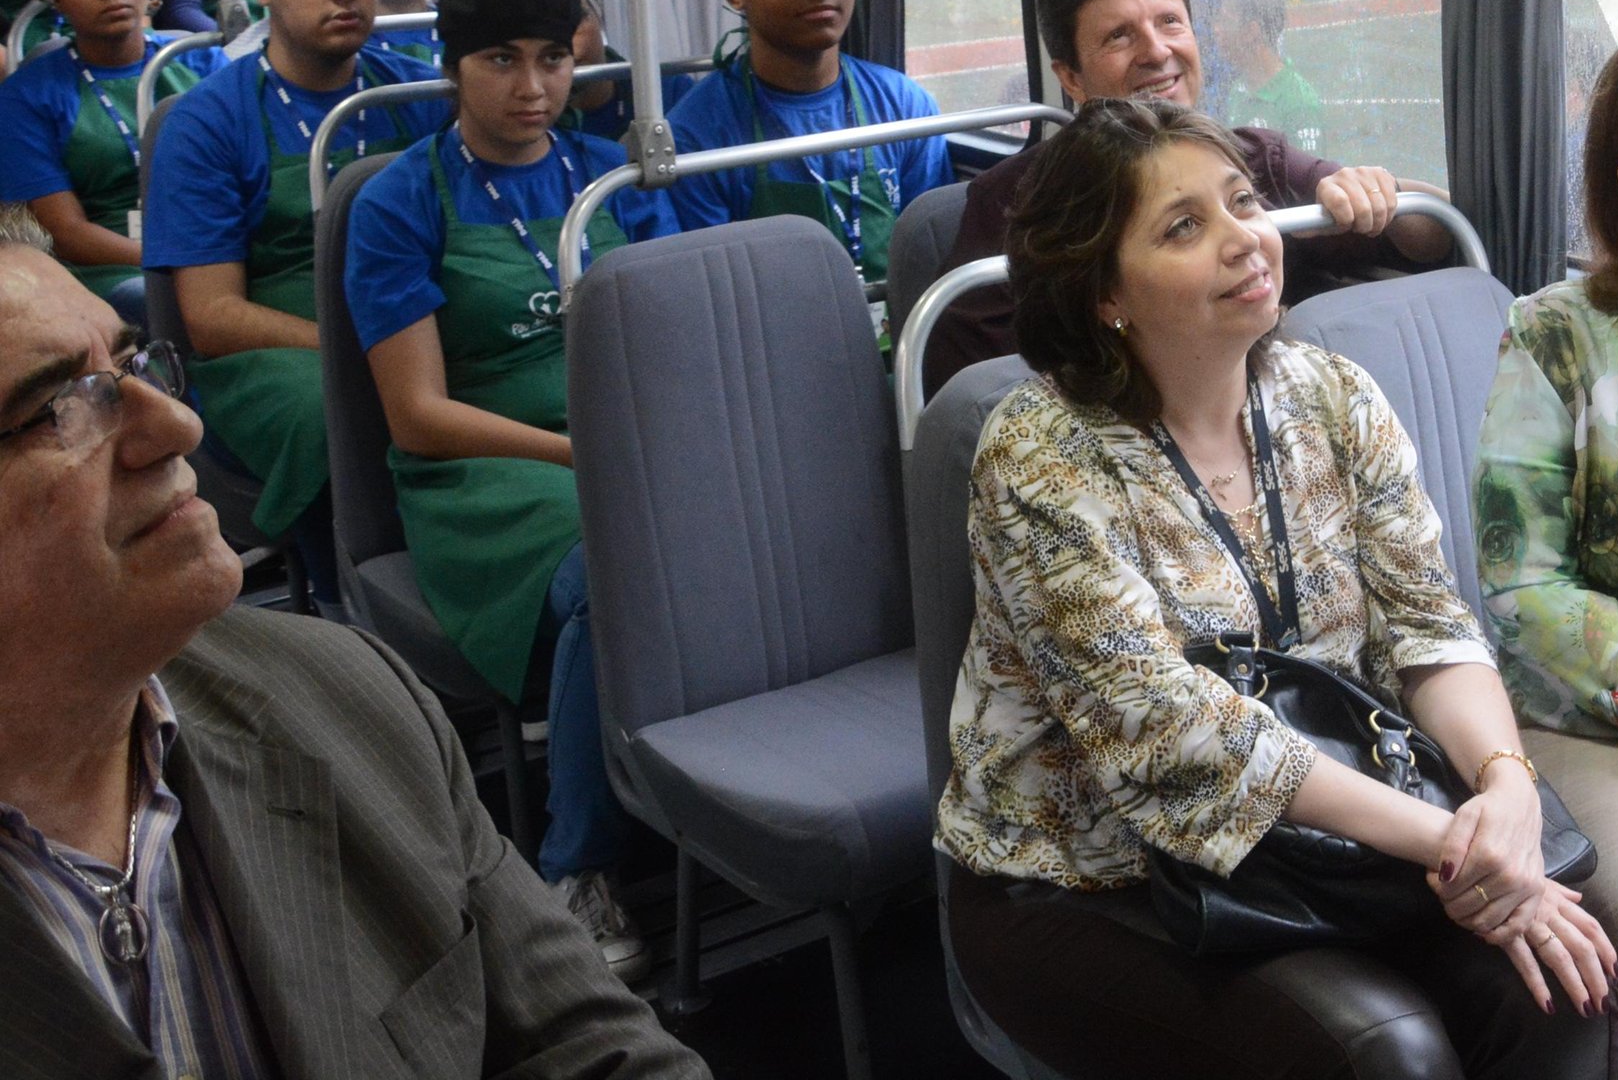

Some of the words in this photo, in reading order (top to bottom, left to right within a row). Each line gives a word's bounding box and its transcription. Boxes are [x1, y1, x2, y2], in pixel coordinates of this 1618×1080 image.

[1263, 460, 1275, 491] Sesc
[1195, 485, 1217, 515] Sesc
[1240, 555, 1259, 585] Sesc
[1276, 540, 1289, 573] Sesc
